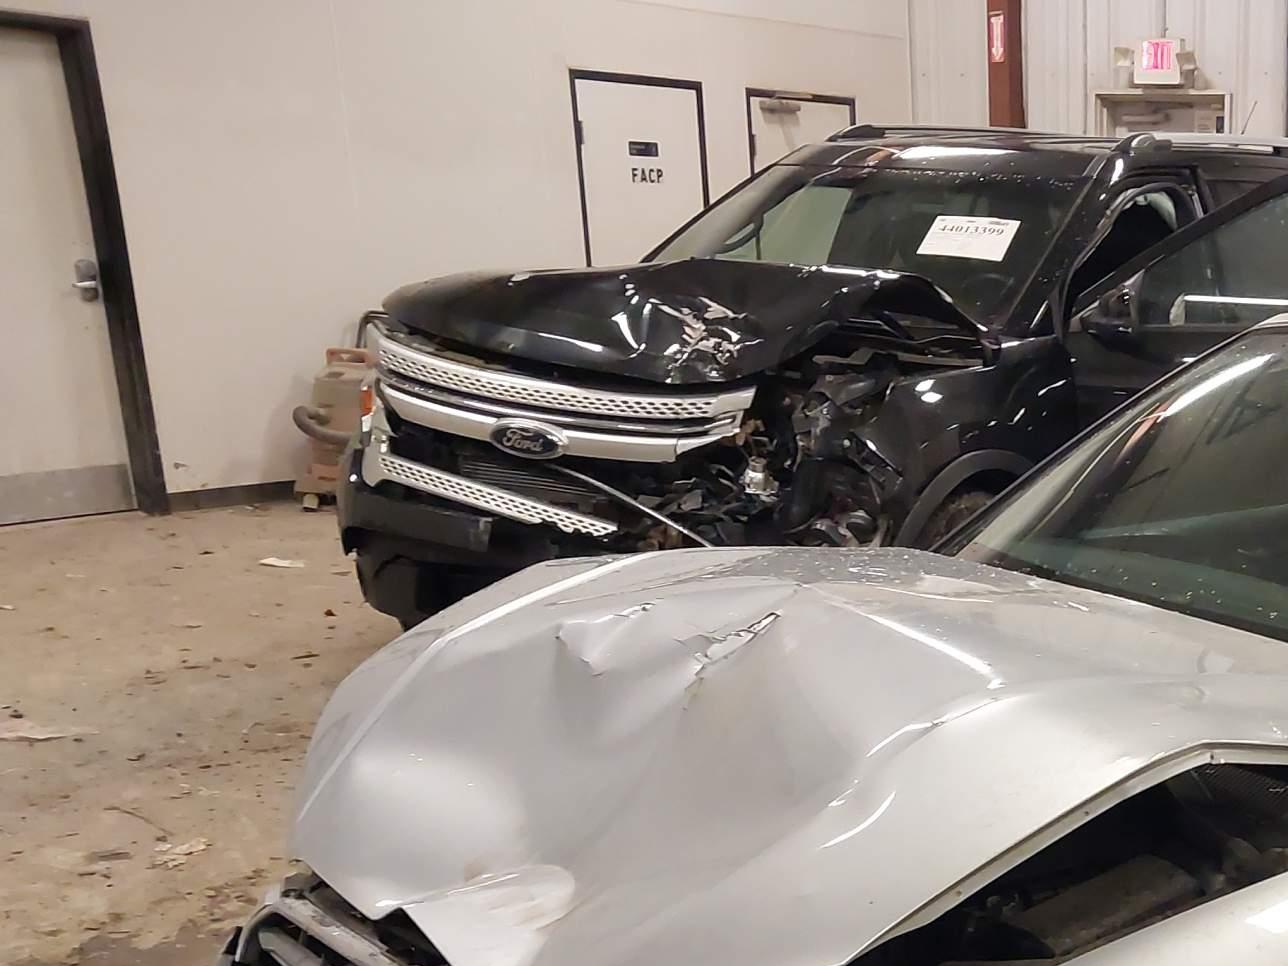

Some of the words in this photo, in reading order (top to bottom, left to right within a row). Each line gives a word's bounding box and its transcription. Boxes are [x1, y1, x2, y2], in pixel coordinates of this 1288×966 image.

[631, 167, 664, 183] FACP
[938, 224, 1004, 236] 44013399
[502, 428, 544, 452] Ford
